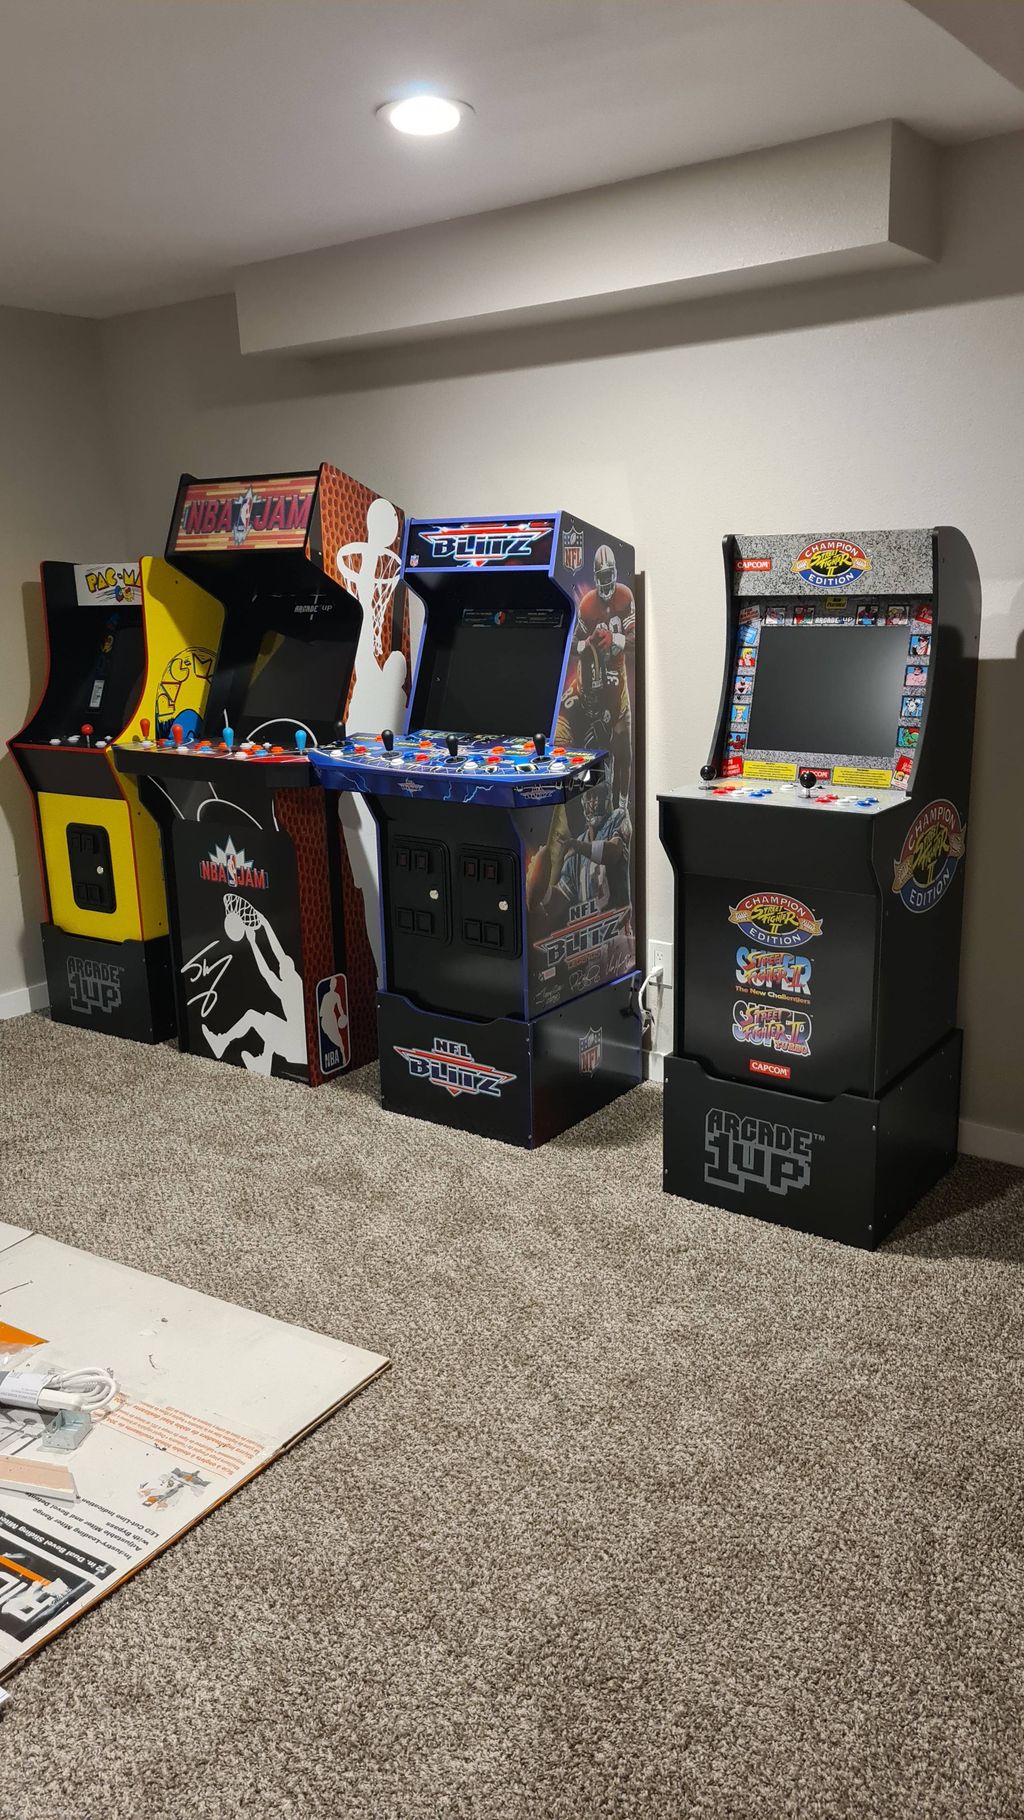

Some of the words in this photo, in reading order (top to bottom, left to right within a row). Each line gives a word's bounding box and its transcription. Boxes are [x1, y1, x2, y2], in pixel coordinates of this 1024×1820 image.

[185, 500, 233, 534] NBA
[253, 494, 313, 530] JAM
[564, 547, 583, 567] NFL
[805, 542, 859, 558] CHAMPION
[737, 561, 769, 569] CAPCOM
[808, 572, 855, 586] EDITION
[908, 806, 956, 851] CHAMPION
[202, 861, 227, 882] NBA
[237, 866, 266, 890] JAM
[909, 868, 950, 907] EDITION
[570, 899, 599, 921] NFL
[745, 896, 806, 917] CHAMPION
[756, 911, 800, 927] FIGHTER
[749, 927, 802, 945] EDITION
[66, 956, 121, 986] ARCADE
[69, 973, 122, 1014] 1UP
[736, 985, 749, 994] The
[750, 987, 767, 997] New
[767, 991, 811, 1005] Challengers
[434, 1038, 472, 1059] NFL
[324, 1050, 340, 1069] NBA
[751, 1061, 788, 1076] CAPCOM
[705, 1107, 813, 1162] ARCADE
[704, 1133, 812, 1195] 1UP
[32, 1507, 53, 1521] Range
[50, 1503, 70, 1517] Bevel
[81, 1497, 116, 1518] Indication
[54, 1518, 73, 1531] Miter
[69, 1512, 83, 1523] and
[84, 1519, 103, 1531] Miter
[116, 1513, 145, 1531] Cut-Line
[19, 1525, 46, 1543] Sliding
[105, 1521, 131, 1537] Bypass
[144, 1527, 159, 1539] LED
[45, 1540, 67, 1554] Bevel
[73, 1527, 132, 1560] Industry-Leading
[103, 1528, 142, 1552] Adjustable
[133, 1534, 149, 1546] with
[66, 1550, 86, 1563] Dual
[87, 1559, 97, 1569] in.
